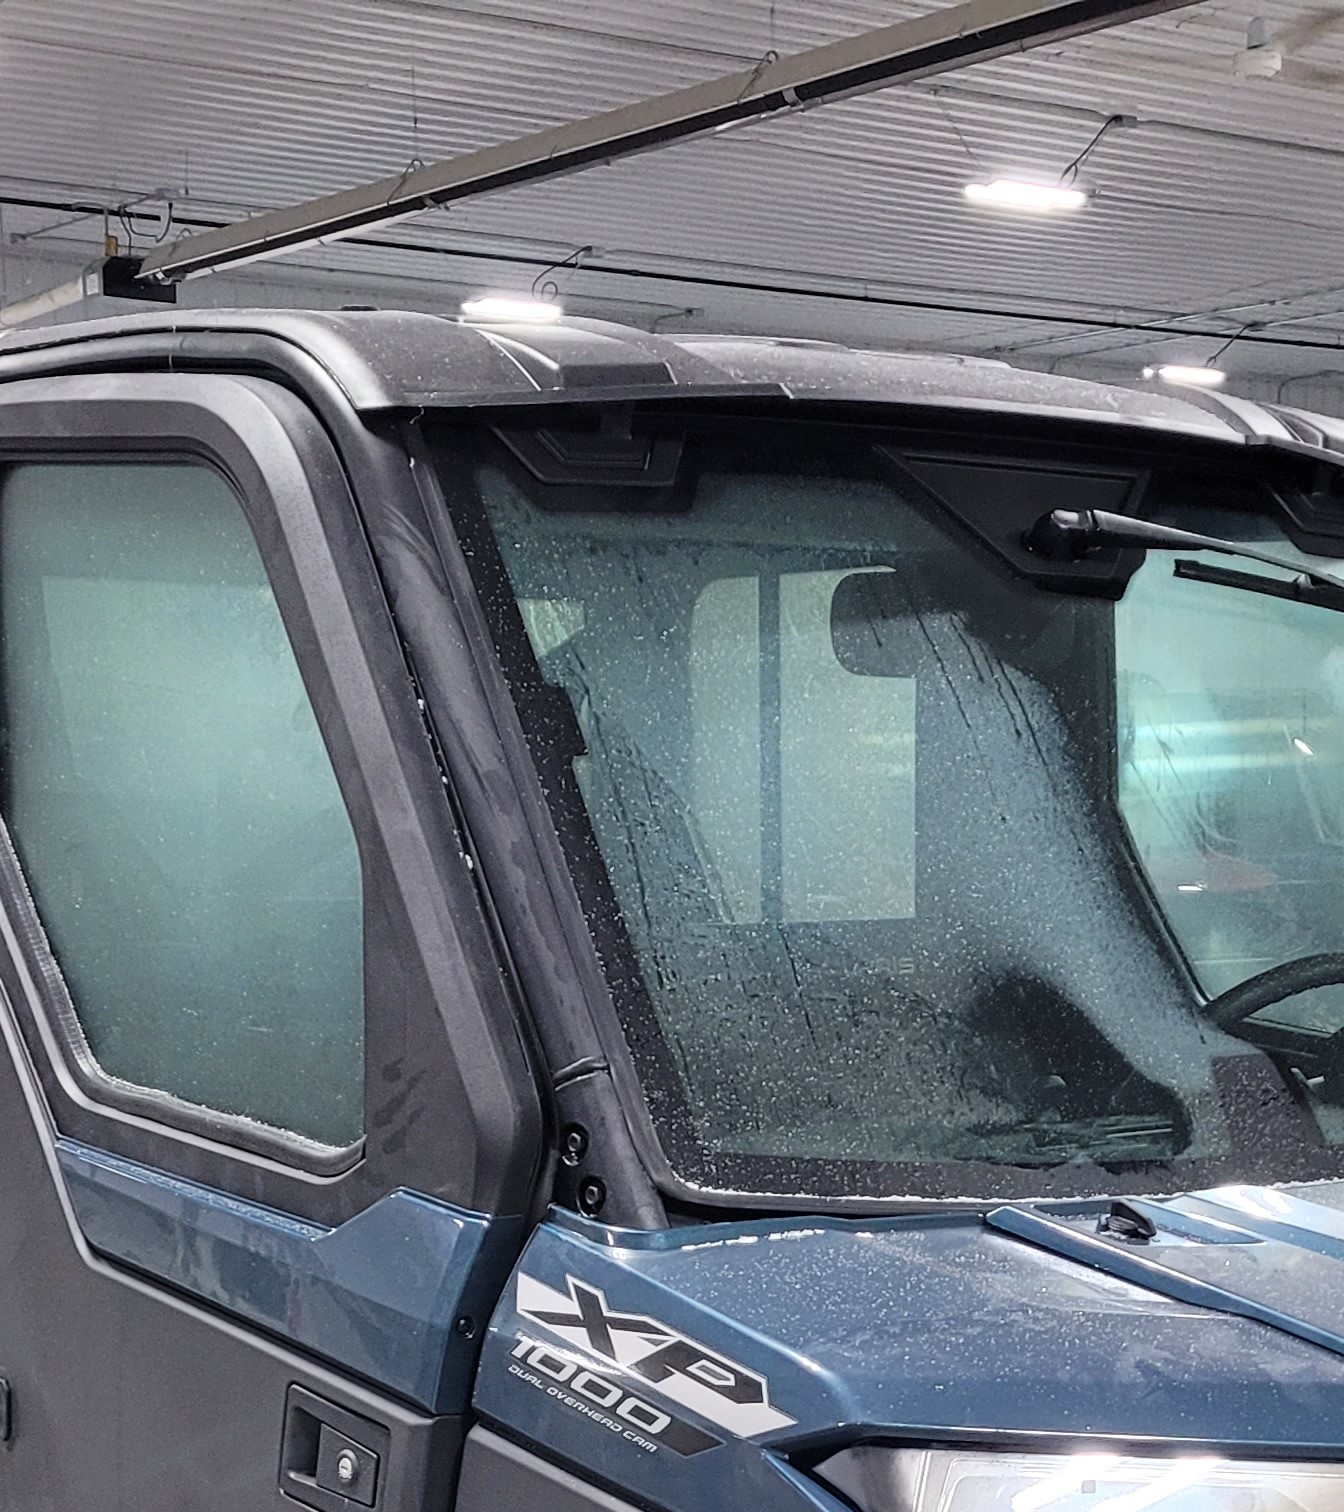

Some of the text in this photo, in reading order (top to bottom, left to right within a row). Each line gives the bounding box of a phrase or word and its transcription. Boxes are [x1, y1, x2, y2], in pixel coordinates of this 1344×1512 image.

[511, 1334, 672, 1435] 1000
[517, 1272, 774, 1412] XP
[507, 1363, 658, 1454] DUAL OVERHEAD CAM
